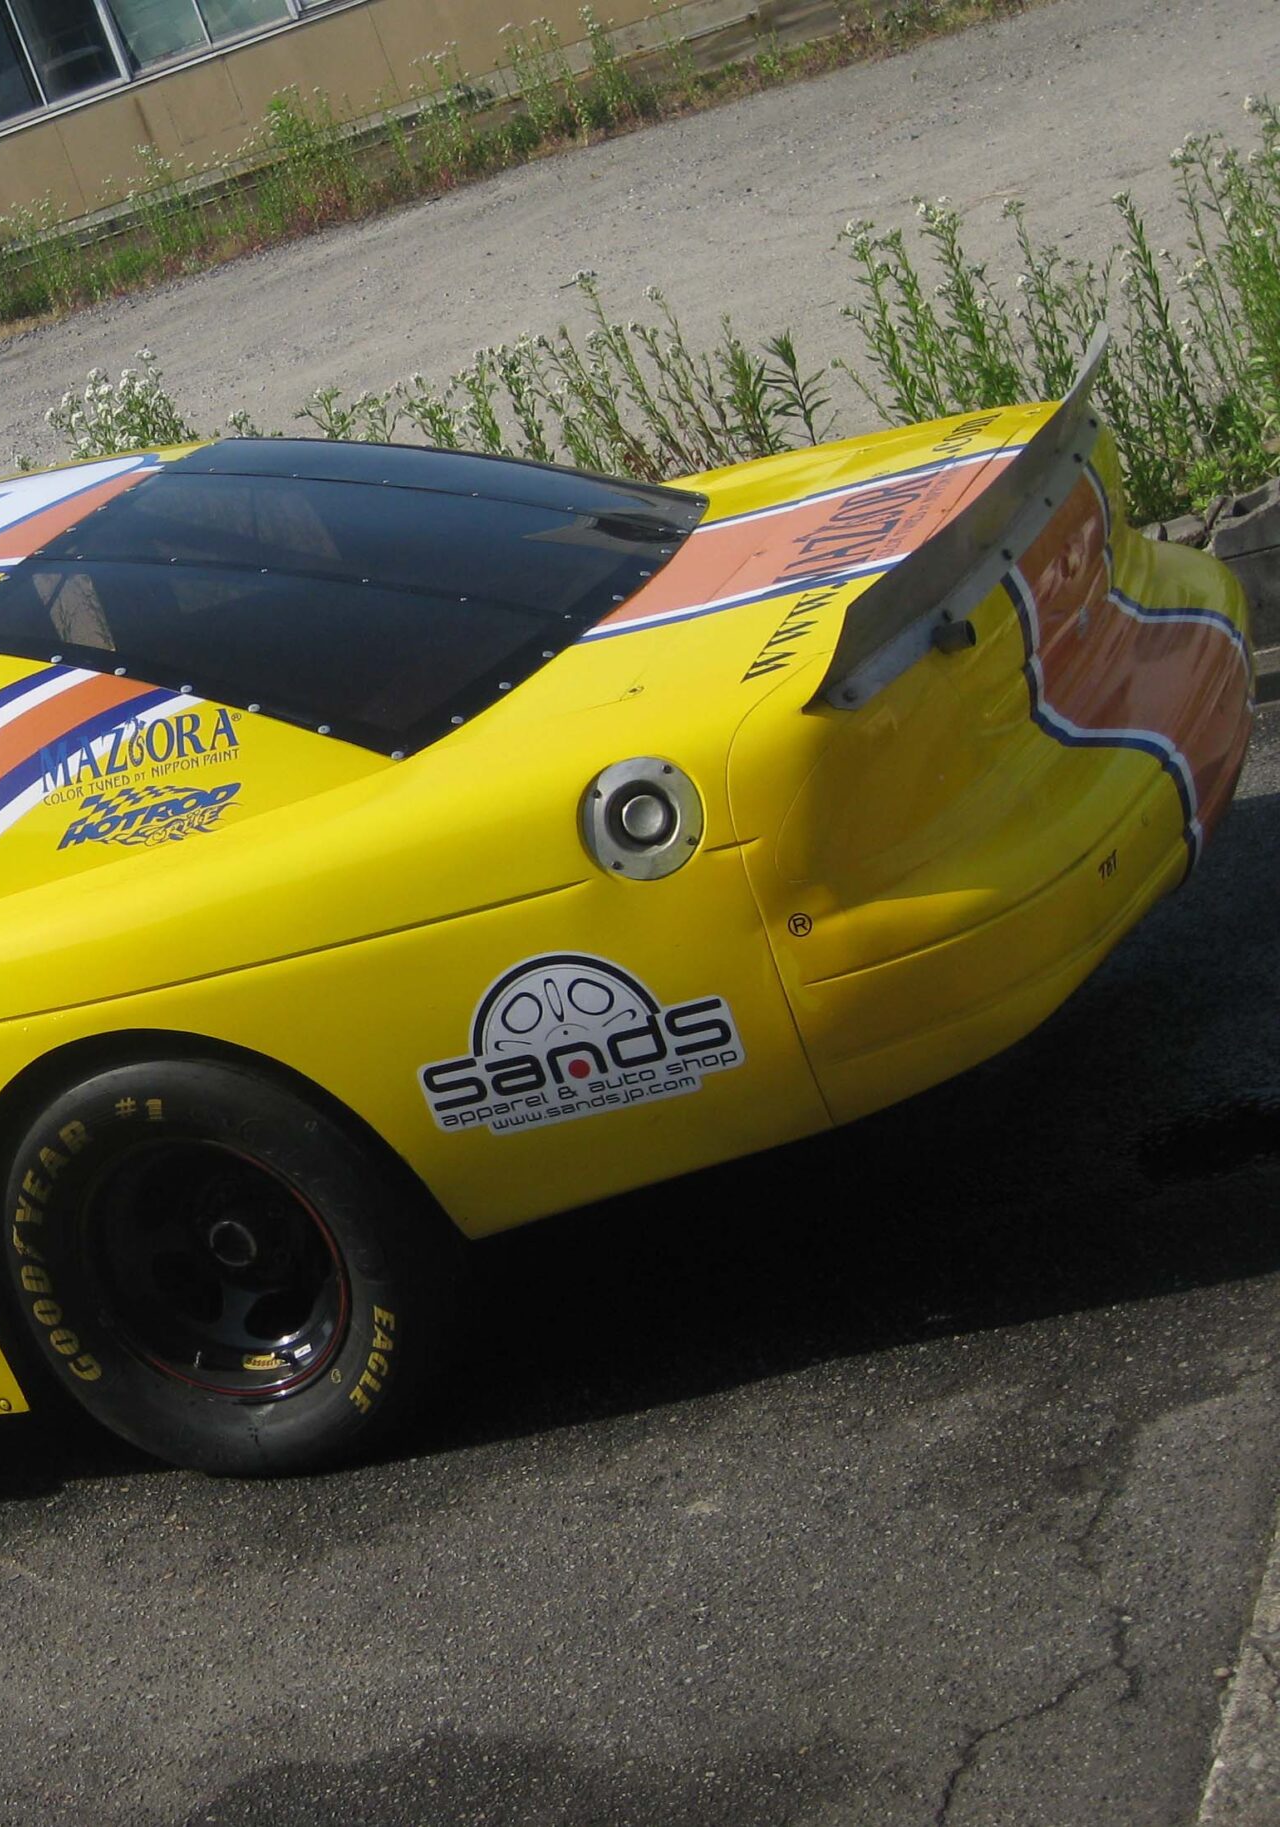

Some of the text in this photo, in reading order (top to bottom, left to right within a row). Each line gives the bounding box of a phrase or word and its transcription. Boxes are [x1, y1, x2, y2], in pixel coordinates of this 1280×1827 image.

[43, 786, 83, 806] COLOR
[89, 776, 130, 793] TUNED
[151, 758, 200, 778] NIPPON
[202, 748, 241, 765] PAINT
[442, 1050, 738, 1127] apparel & auto shop
[492, 1075, 696, 1130] www.sandsjp.com
[348, 1304, 397, 1414] EAGLE
